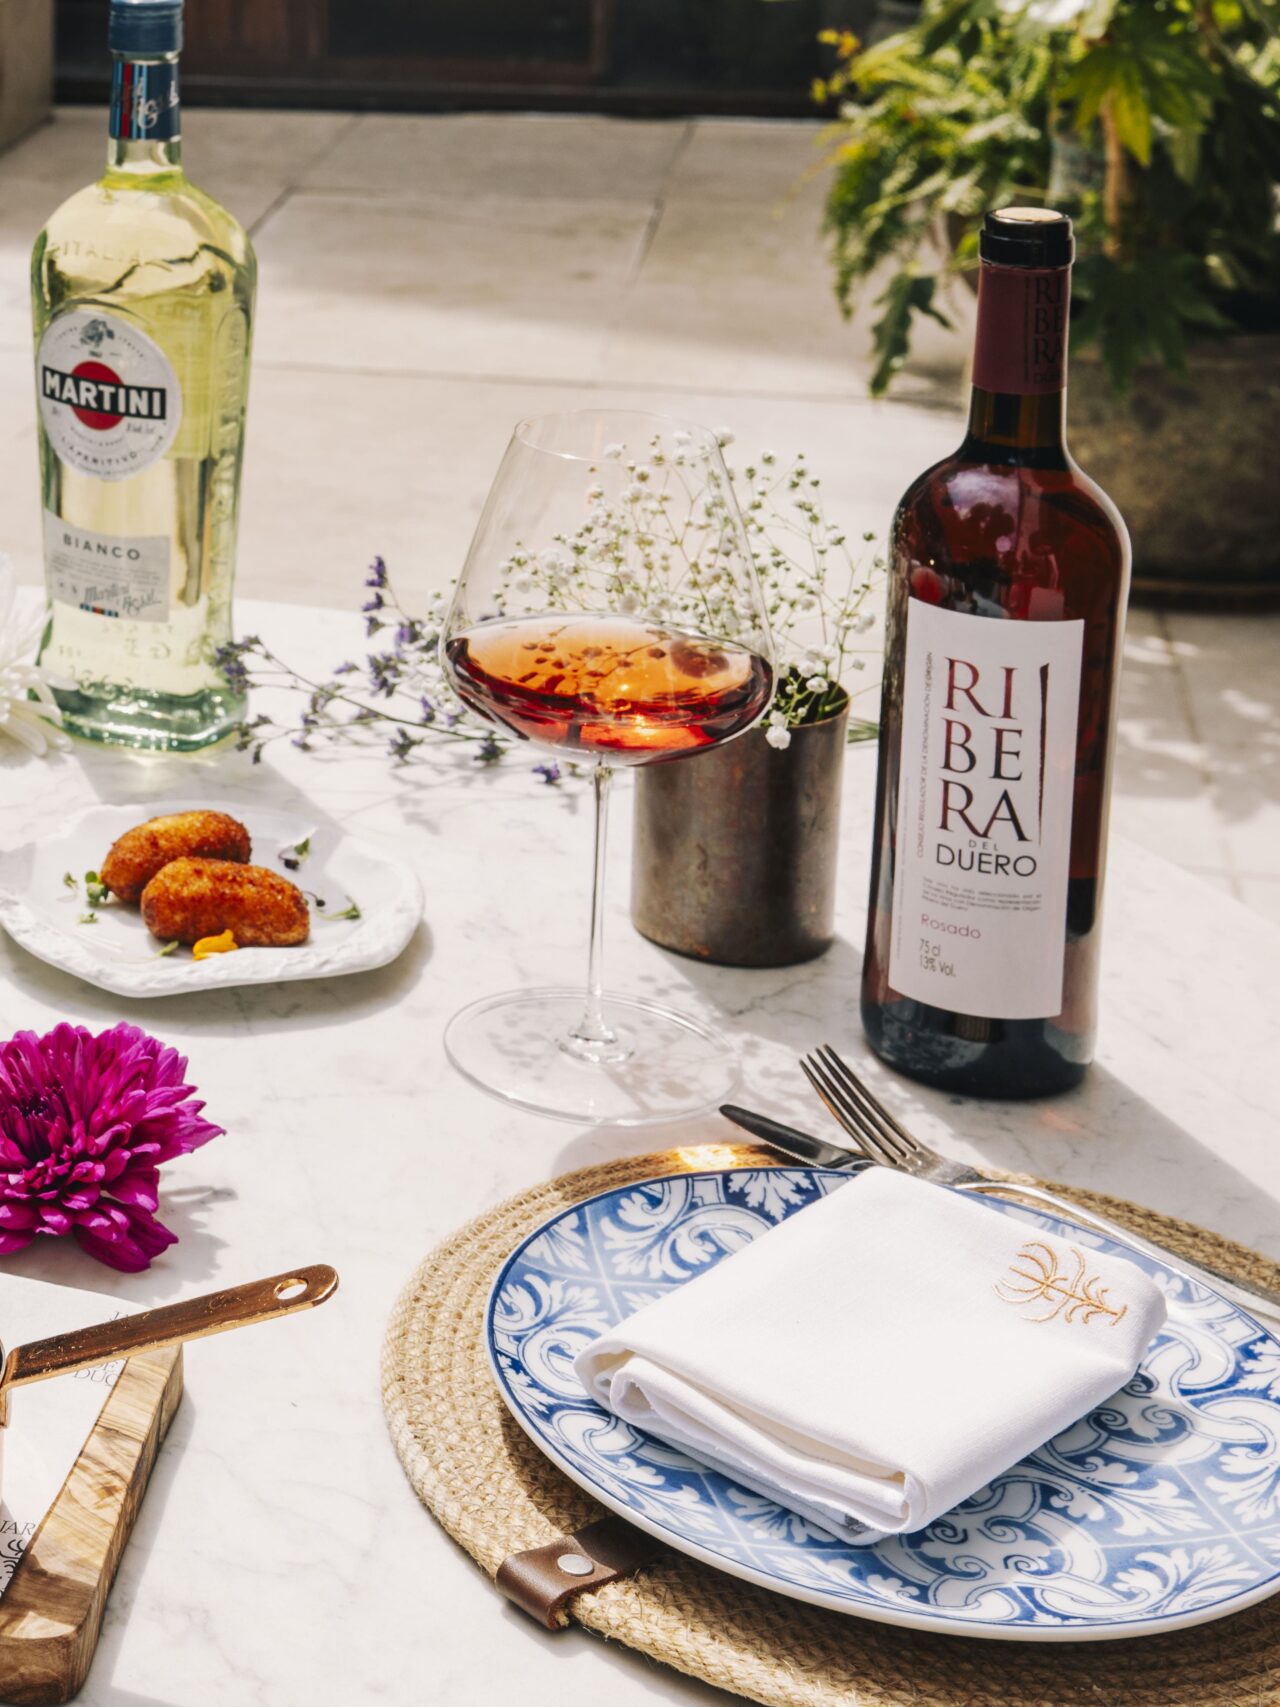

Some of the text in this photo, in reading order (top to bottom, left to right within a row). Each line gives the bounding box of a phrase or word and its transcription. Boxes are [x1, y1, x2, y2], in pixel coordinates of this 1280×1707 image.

[45, 368, 162, 418] MARTINI
[63, 533, 141, 561] BIANCO
[968, 839, 999, 851] DEL
[936, 843, 1037, 877] DUERO
[921, 913, 982, 939] Rosado
